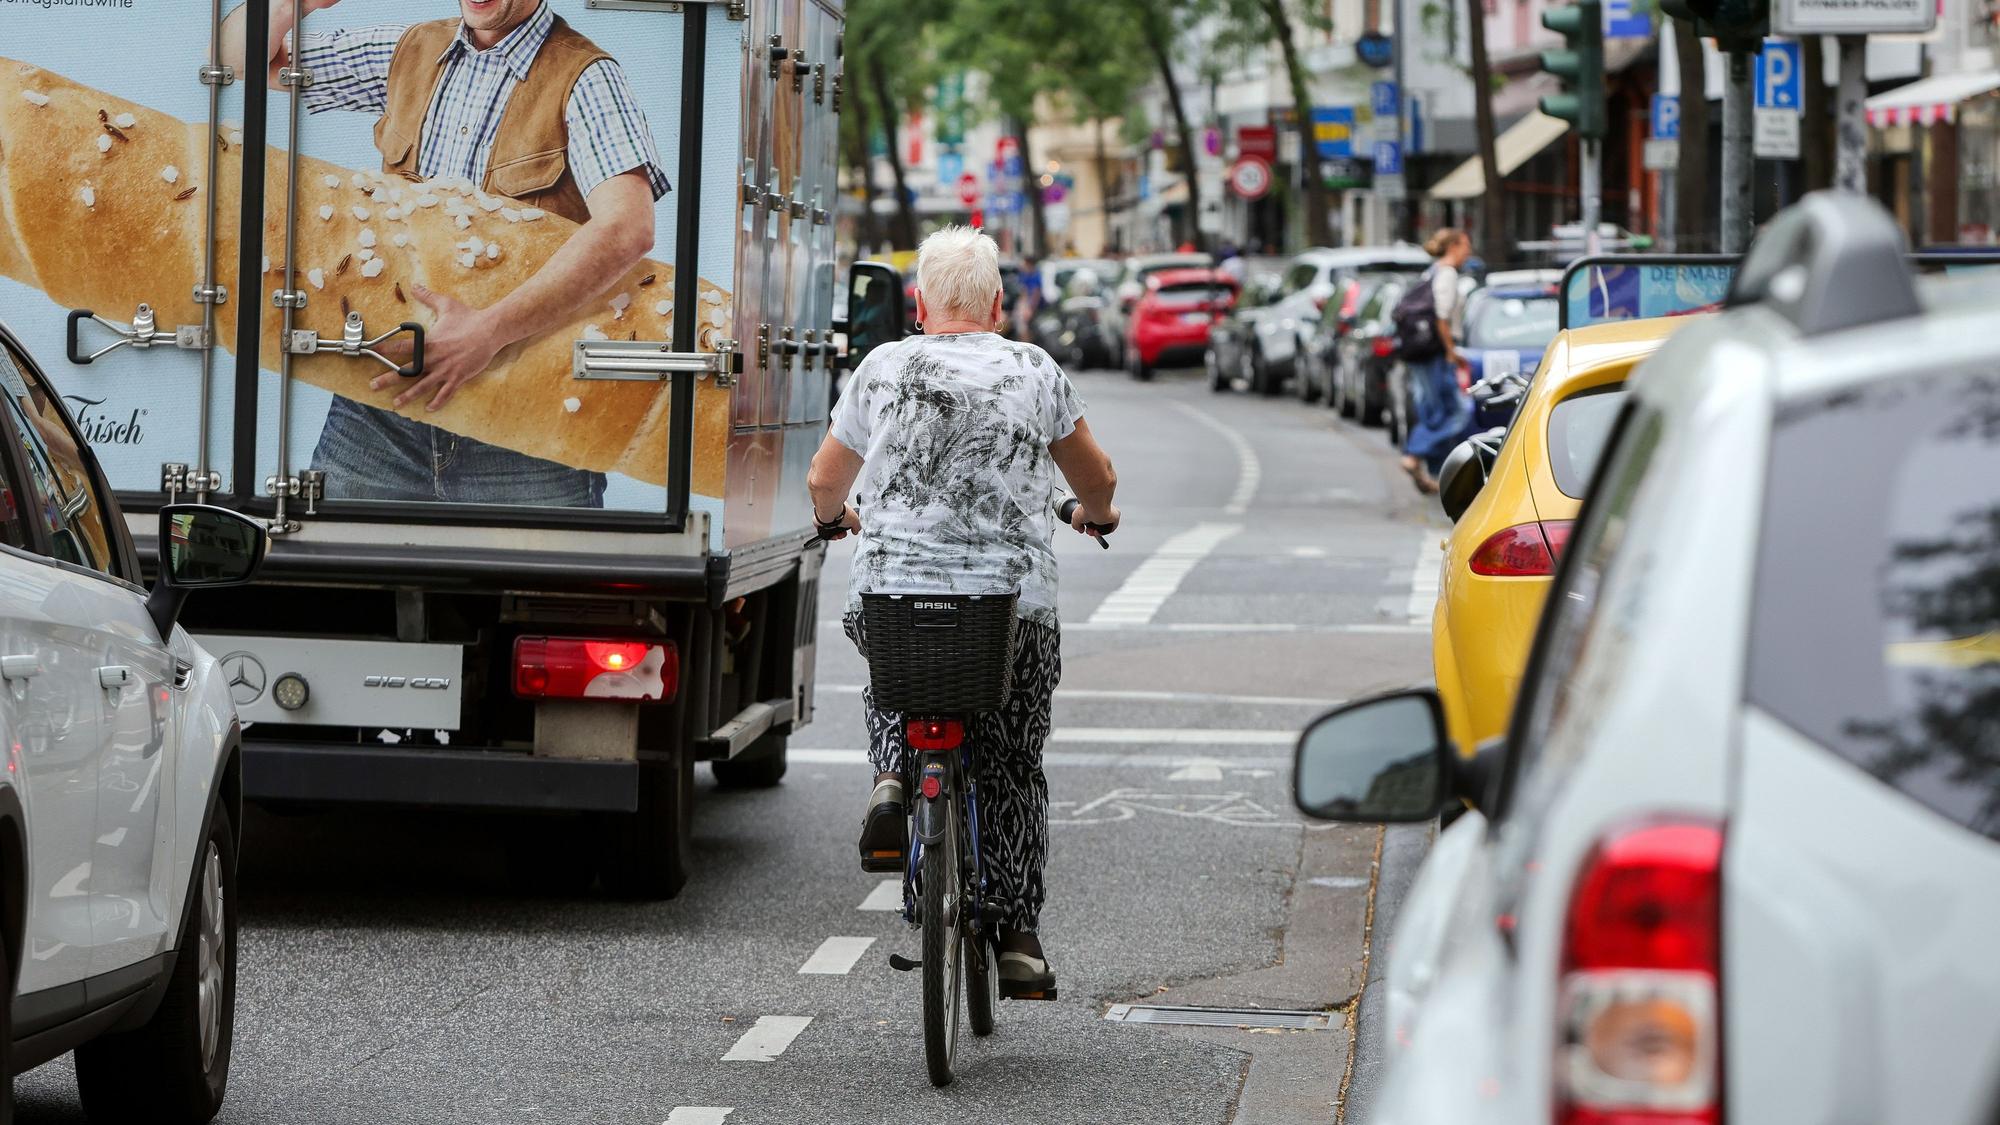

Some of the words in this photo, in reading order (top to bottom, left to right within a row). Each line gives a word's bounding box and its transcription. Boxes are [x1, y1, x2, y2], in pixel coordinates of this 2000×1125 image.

[1765, 48, 1793, 107] P
[61, 395, 144, 445] Frisch
[914, 602, 957, 610] BASIL
[410, 677, 450, 689] CDI
